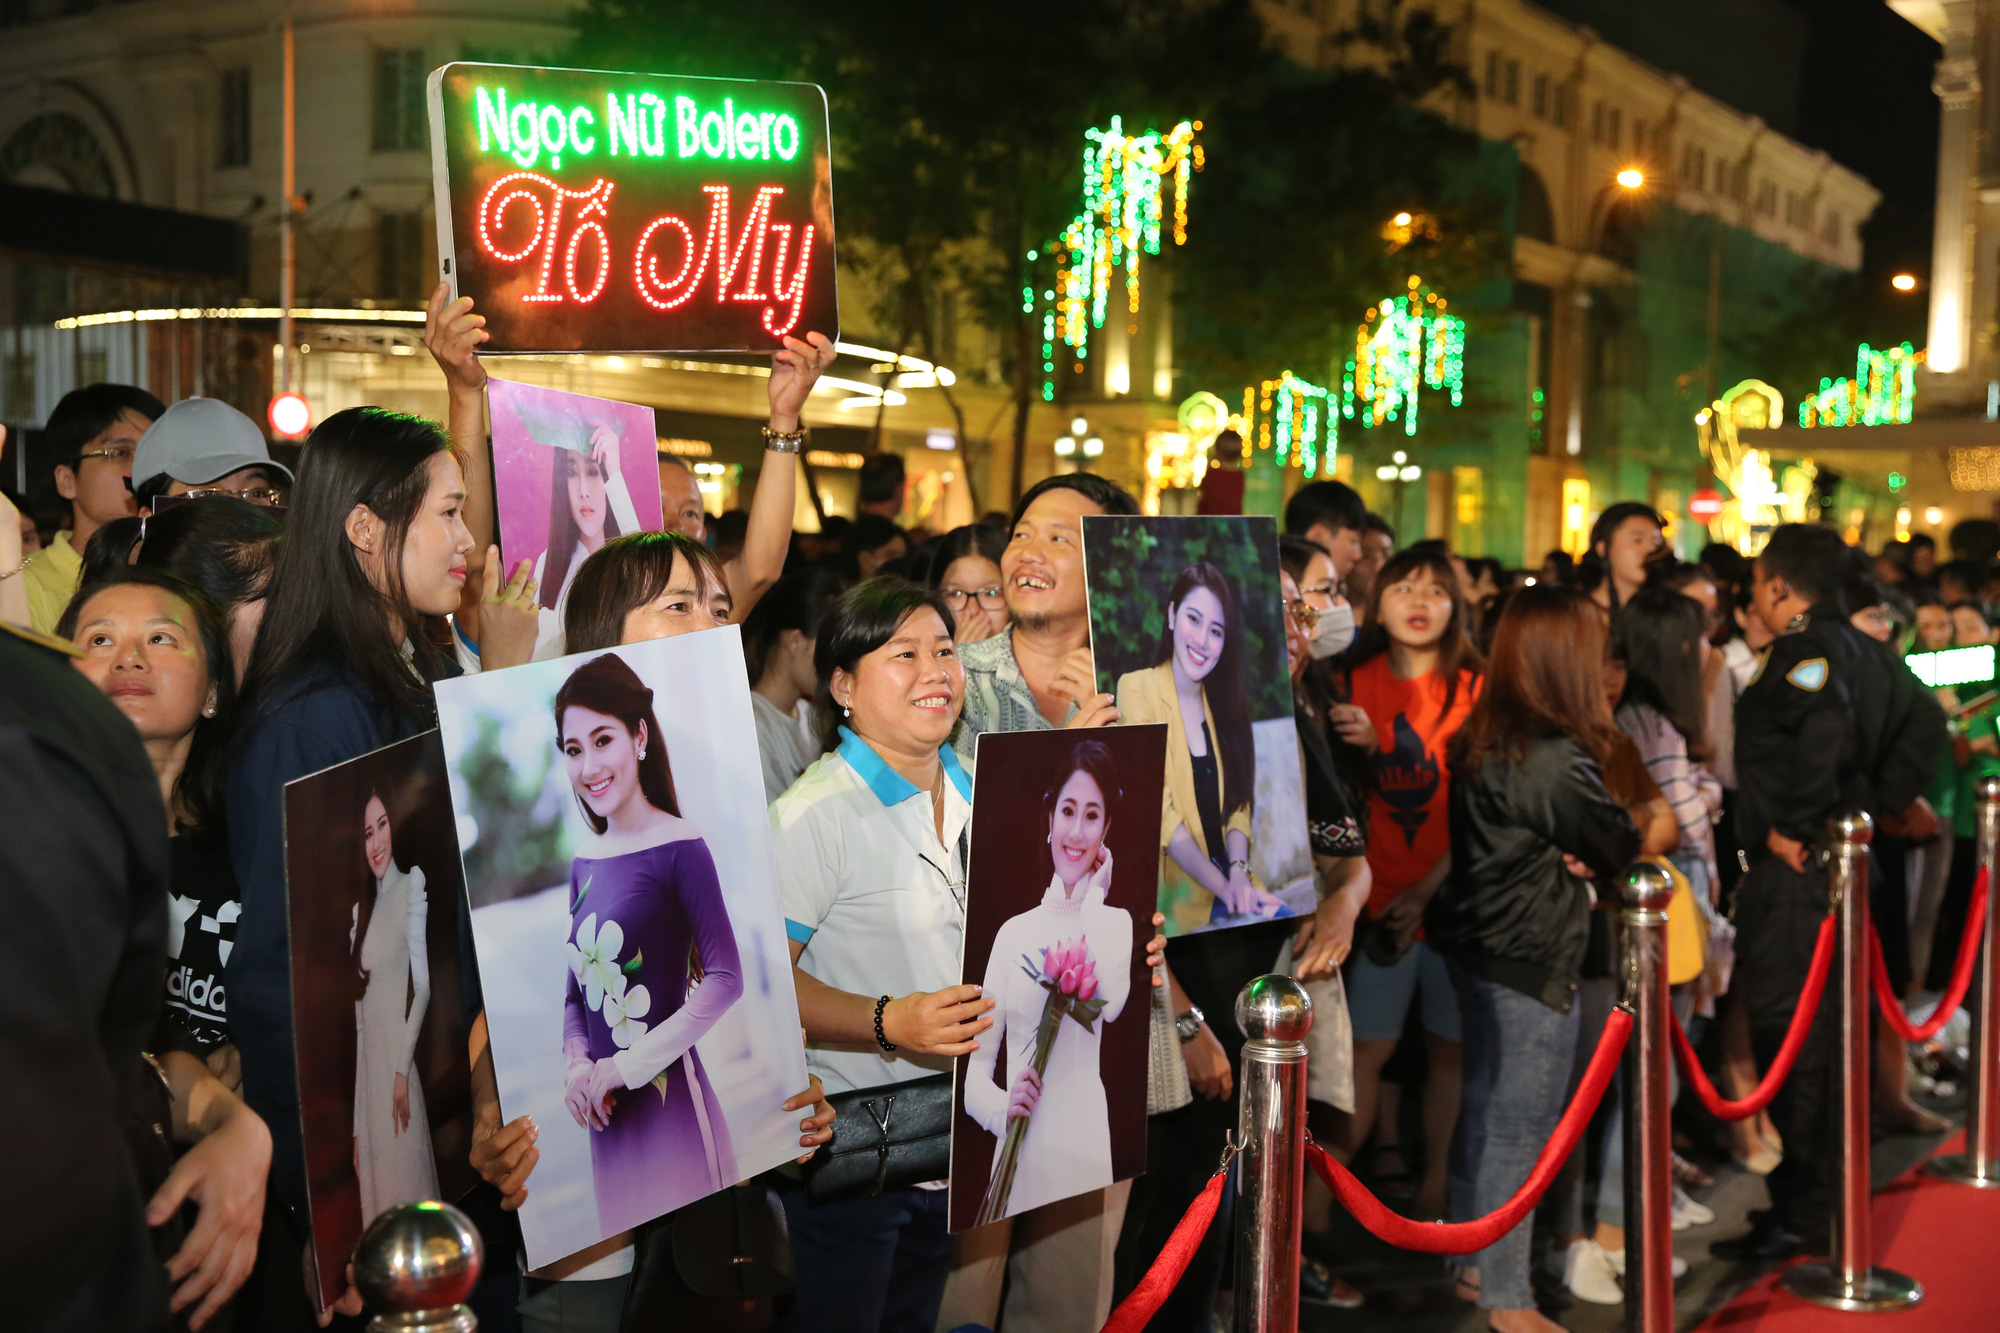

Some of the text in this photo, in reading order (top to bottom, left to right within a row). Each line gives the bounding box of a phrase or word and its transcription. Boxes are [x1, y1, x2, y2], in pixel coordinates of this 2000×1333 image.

[475, 86, 800, 171] Ngọc Nữ Bolero
[478, 171, 816, 336] Tố My
[166, 965, 227, 1013] dida
